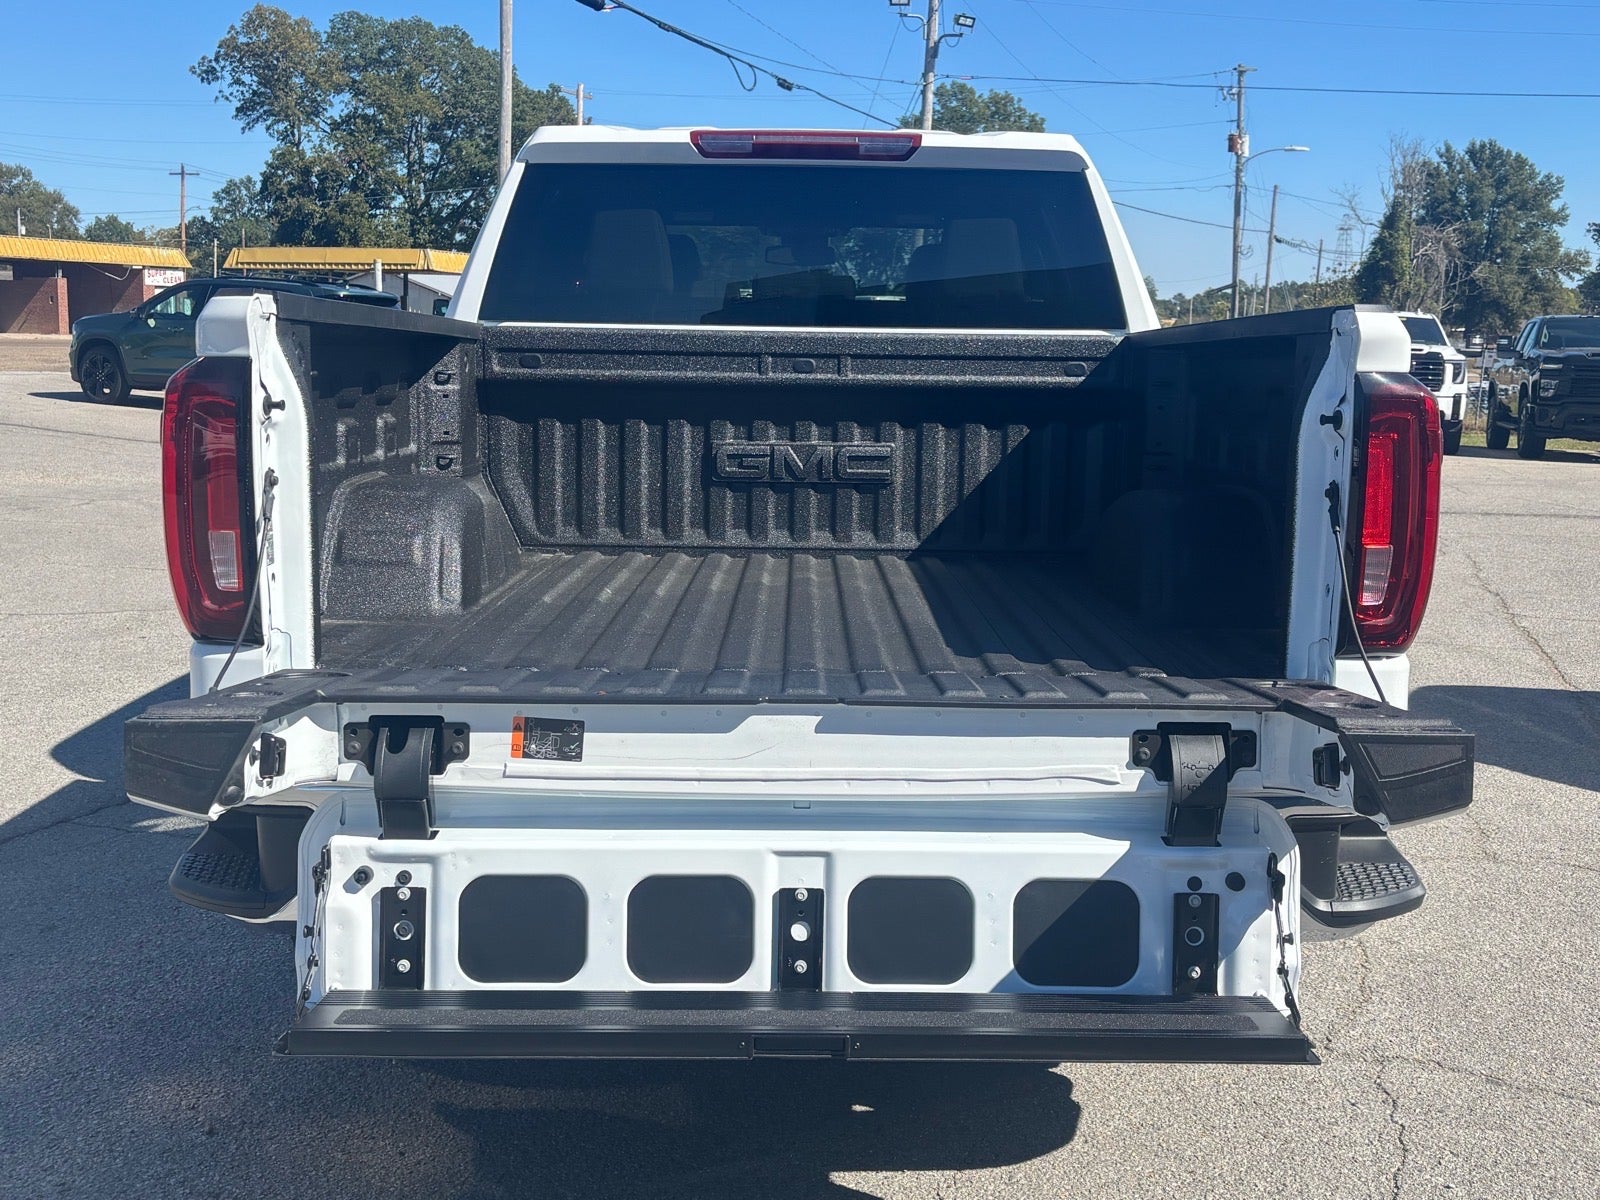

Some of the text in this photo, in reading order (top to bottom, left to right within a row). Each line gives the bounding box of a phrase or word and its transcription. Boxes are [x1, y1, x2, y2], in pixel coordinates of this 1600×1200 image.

[147, 269, 167, 278] SUPER
[163, 276, 182, 284] CLEAN
[715, 445, 891, 481] GMC
